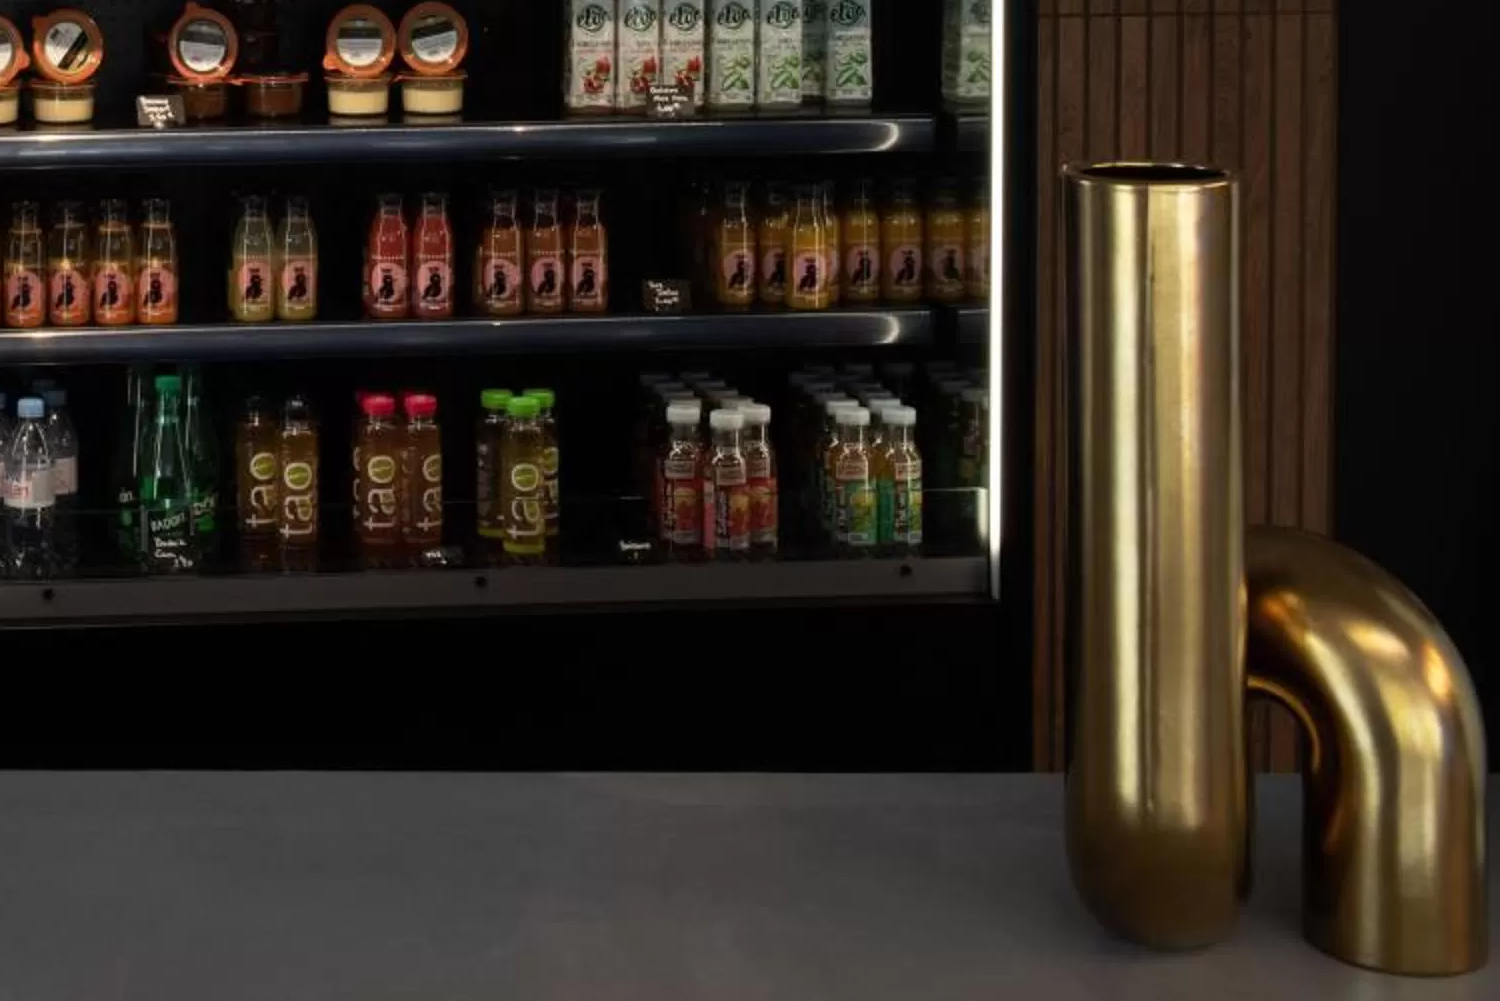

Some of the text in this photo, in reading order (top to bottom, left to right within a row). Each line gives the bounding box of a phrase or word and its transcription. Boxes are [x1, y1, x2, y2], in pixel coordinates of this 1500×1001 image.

[245, 451, 276, 529] tao
[280, 461, 312, 539] tao
[363, 454, 396, 531] tao
[416, 454, 442, 531] tao
[506, 462, 540, 540] tao
